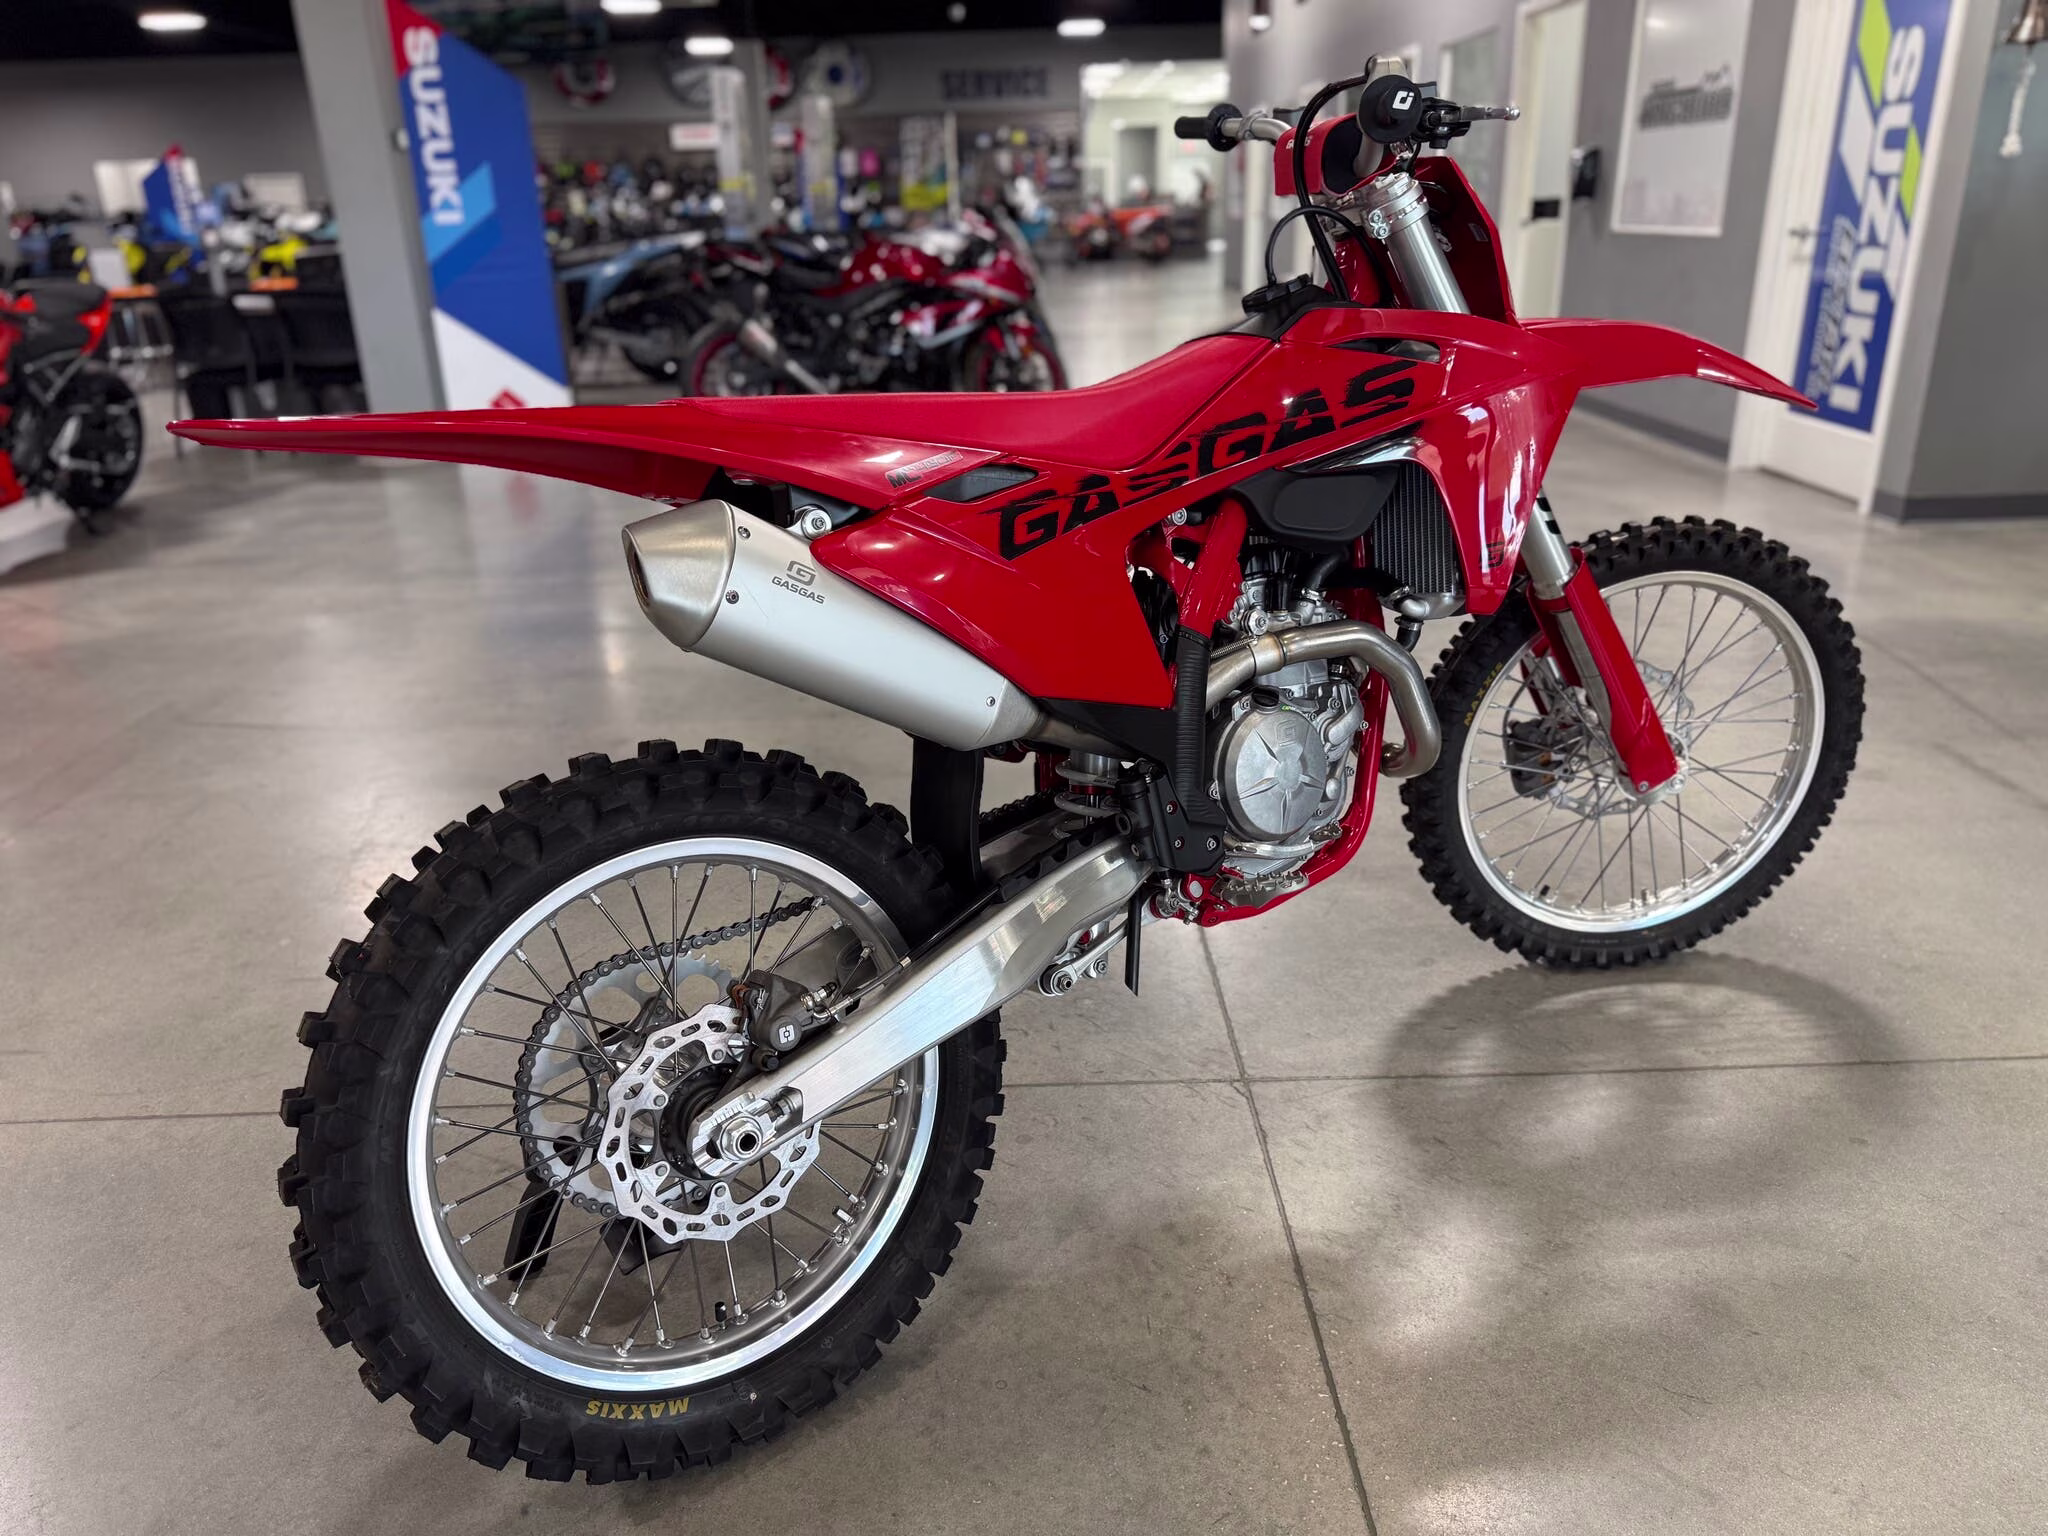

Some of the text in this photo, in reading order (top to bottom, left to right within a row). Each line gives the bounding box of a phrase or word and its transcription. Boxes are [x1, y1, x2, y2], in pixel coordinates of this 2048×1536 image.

[403, 25, 465, 225] SUZUKI
[1829, 25, 1925, 413] SUZUKI
[976, 359, 1418, 562] GASGAS
[771, 575, 826, 605] GASGAS
[585, 1396, 690, 1421] MAXXIS
